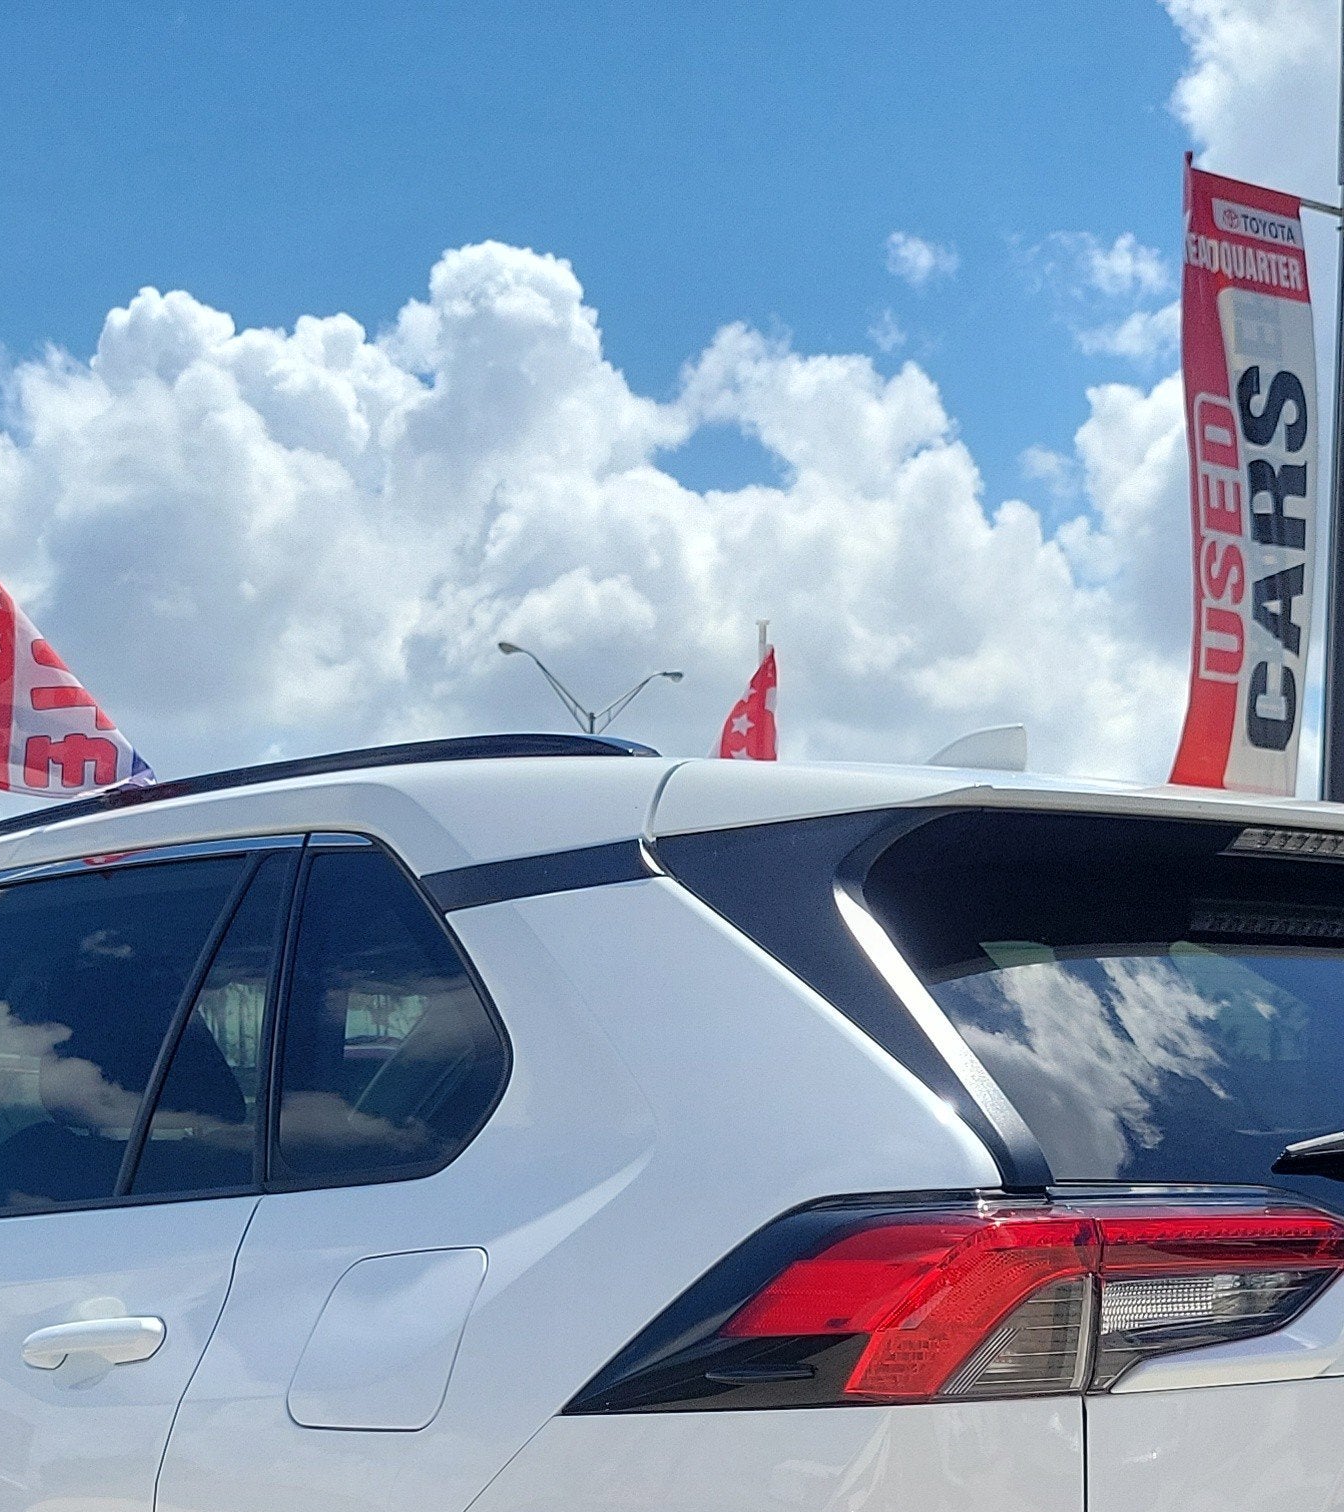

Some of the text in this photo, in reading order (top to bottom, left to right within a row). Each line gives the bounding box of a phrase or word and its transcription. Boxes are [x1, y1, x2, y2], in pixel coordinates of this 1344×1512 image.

[1185, 232, 1304, 292] EADQUARTER
[1240, 214, 1296, 243] TOYOTA
[1195, 393, 1246, 683] USED
[1236, 365, 1309, 752] CARS
